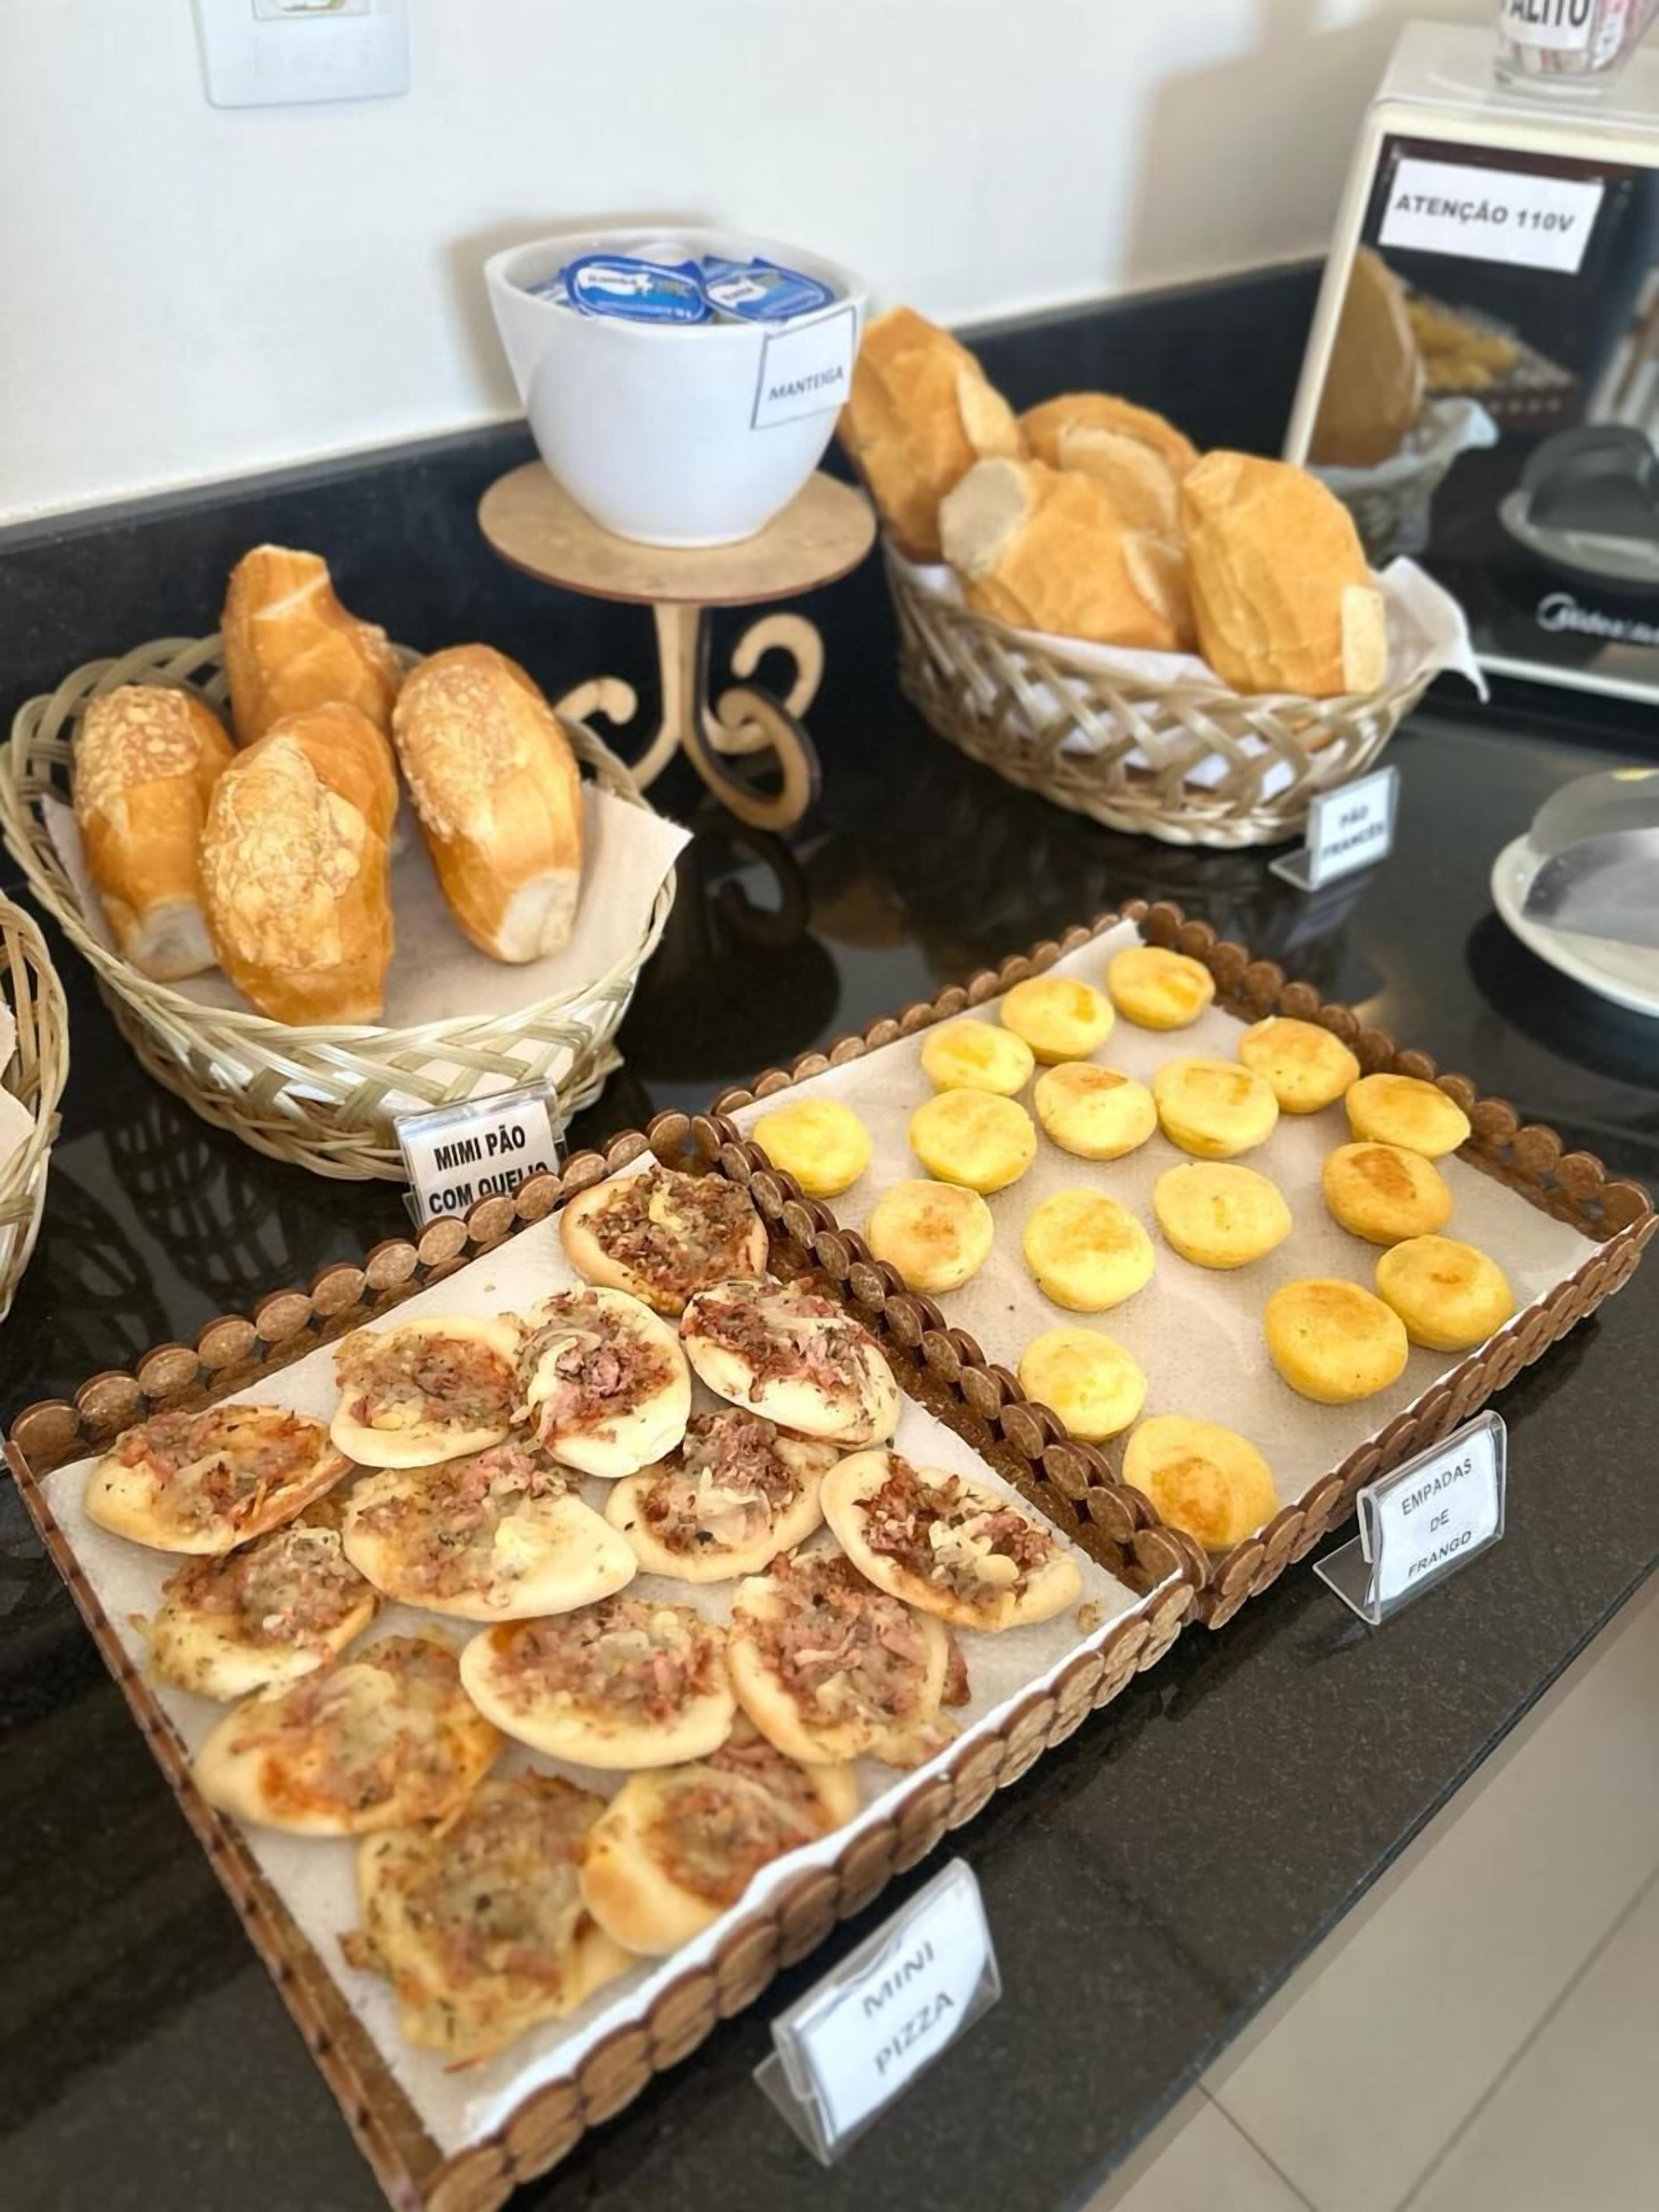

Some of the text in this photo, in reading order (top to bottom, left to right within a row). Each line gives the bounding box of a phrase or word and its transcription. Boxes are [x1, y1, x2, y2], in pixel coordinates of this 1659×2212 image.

[1395, 194, 1575, 232] ATENÇÃO 110V
[768, 365, 843, 401] MANTEIGA
[434, 1124, 526, 1171] MIMI PÃO
[429, 1183, 474, 1214] COM
[1402, 1458, 1471, 1516] EMPADAS
[1430, 1508, 1449, 1532] DE
[1408, 1531, 1471, 1578] FRANGO
[863, 1940, 934, 2018] MINI
[875, 1992, 954, 2075] PIZZA
